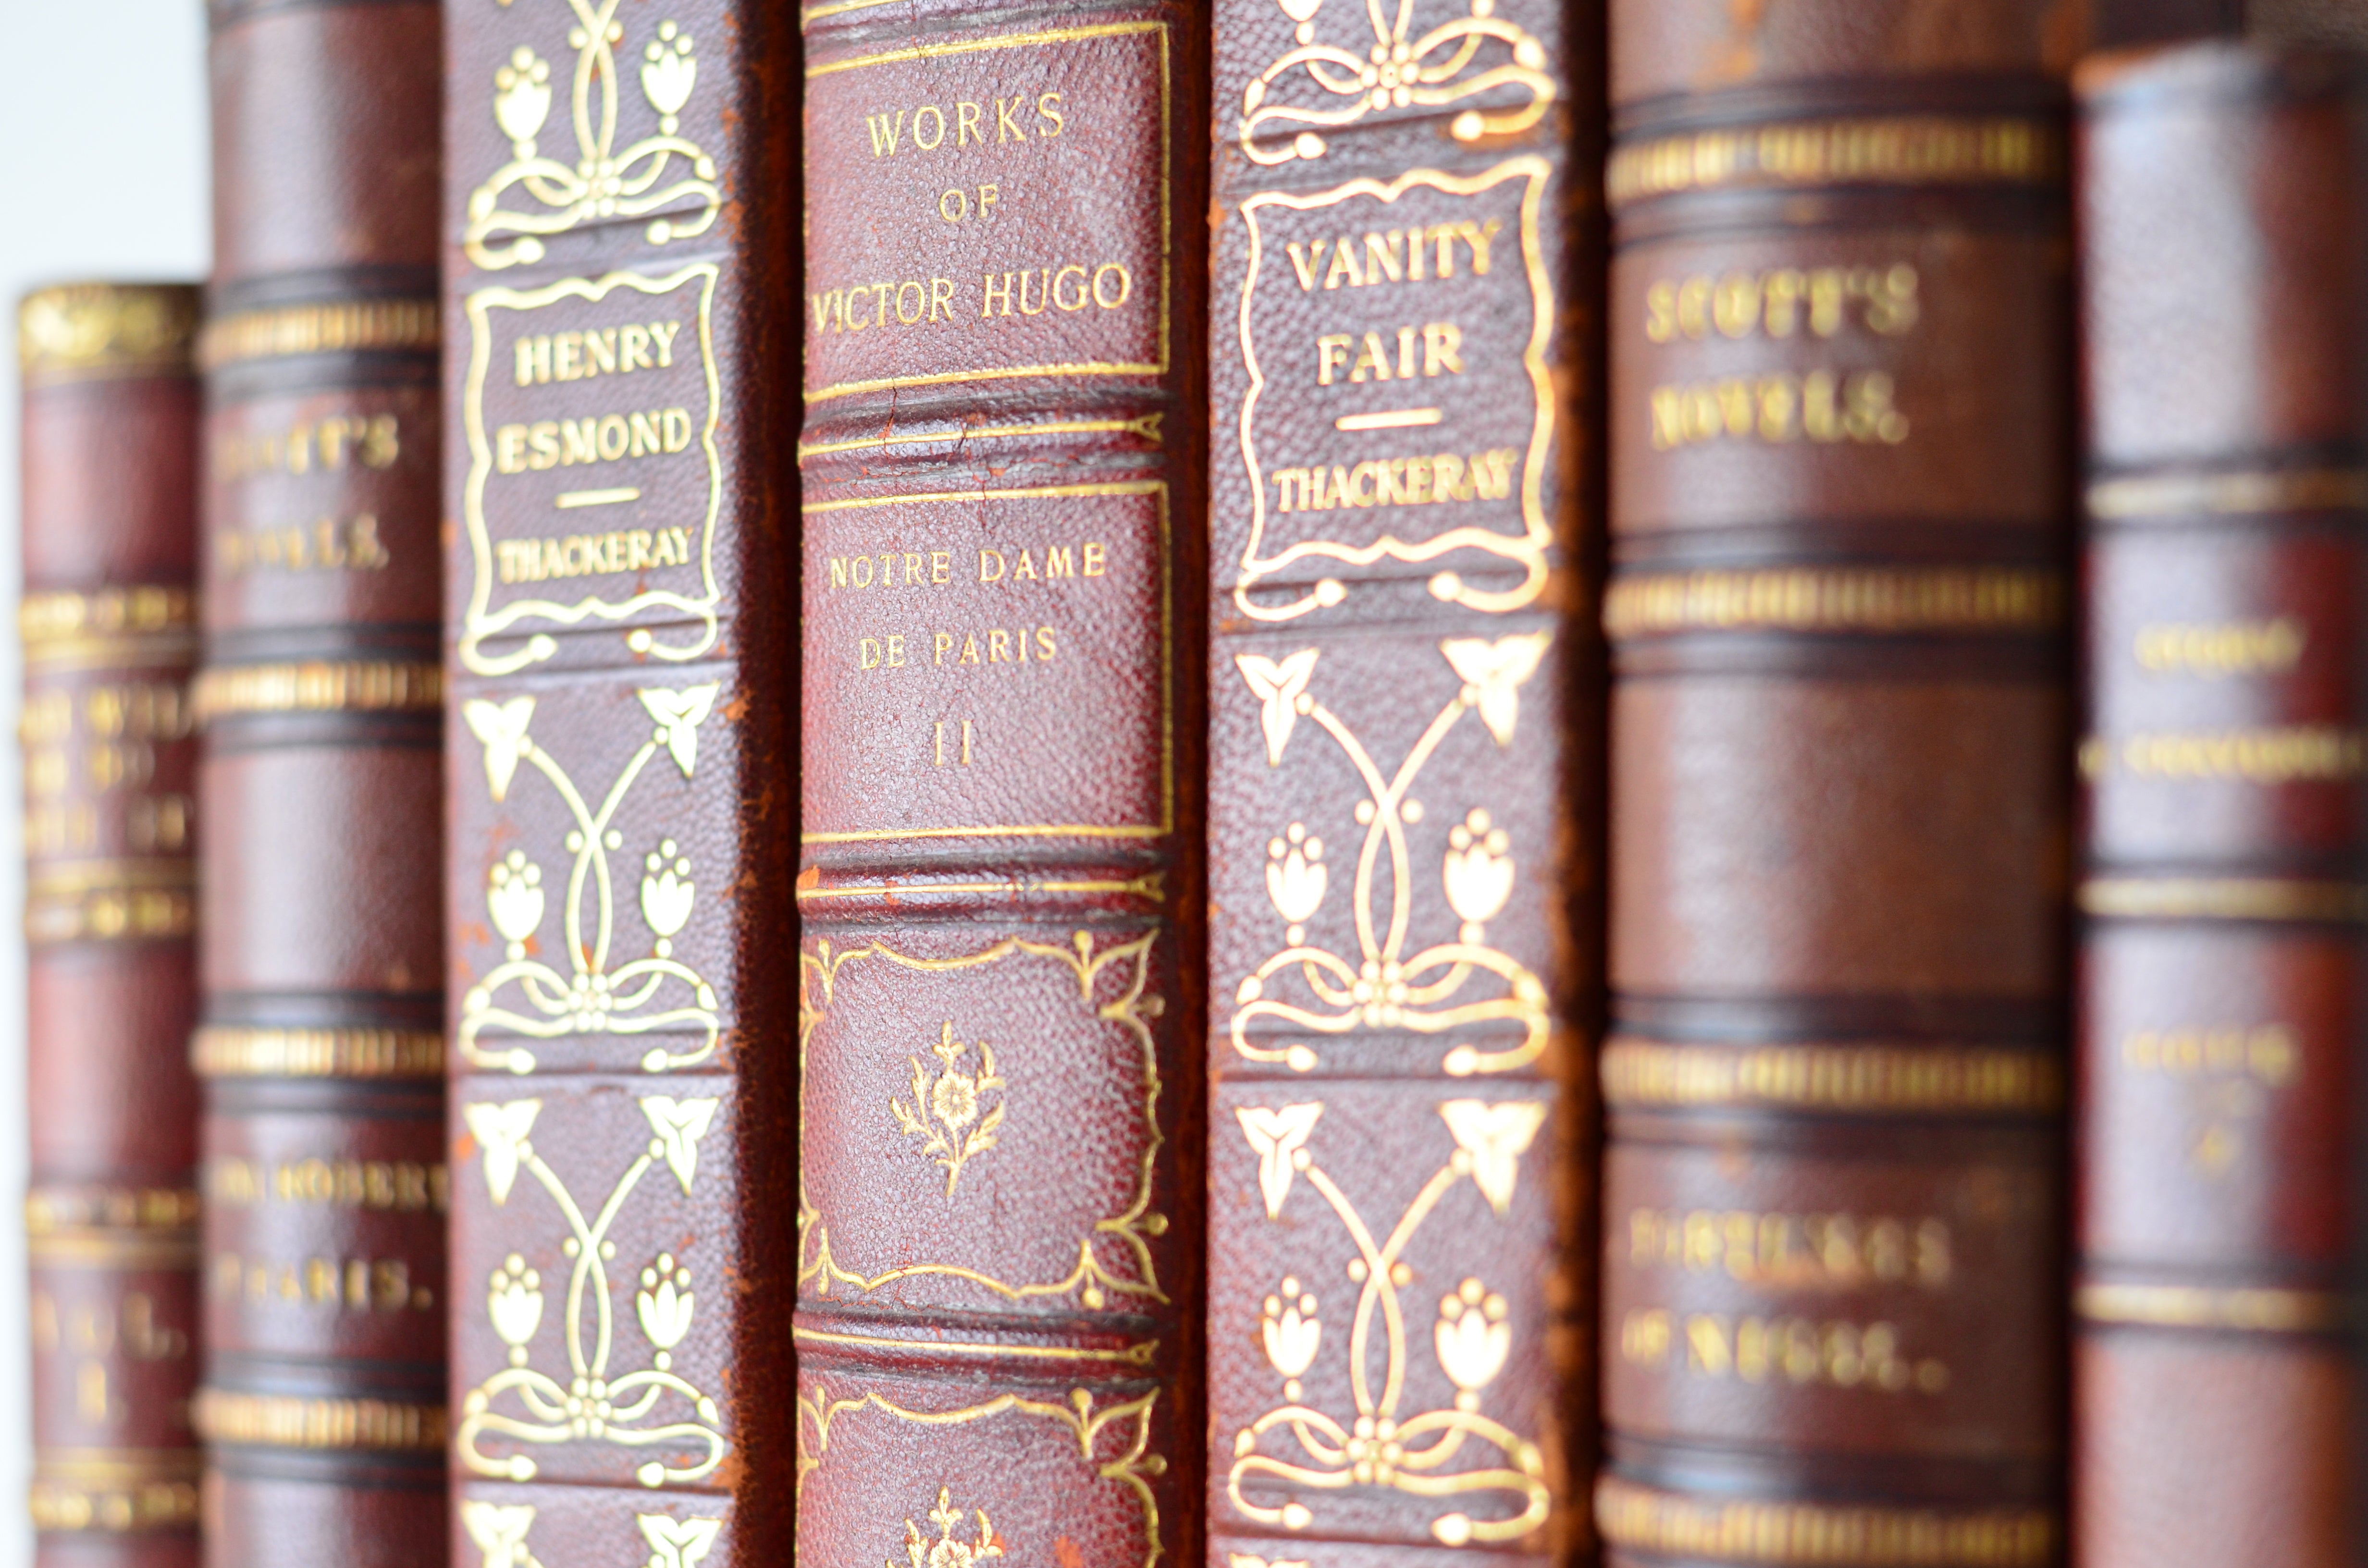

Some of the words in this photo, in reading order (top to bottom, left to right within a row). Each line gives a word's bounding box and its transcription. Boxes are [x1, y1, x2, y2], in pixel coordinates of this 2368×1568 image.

[866, 92, 1063, 158] WORKS
[939, 184, 998, 222] OF
[1286, 217, 1503, 291] VANITY
[813, 278, 954, 335] VICTOR
[982, 262, 1131, 318] HUGO
[515, 320, 680, 386] HENRY
[1317, 322, 1466, 386] FAIR
[496, 407, 691, 474] ESMOND
[1272, 447, 1517, 513] THACKERAY
[496, 526, 693, 584] THACKERAY
[830, 551, 951, 589] NOTRE
[979, 542, 1106, 582] DAME
[860, 635, 905, 670] DE
[934, 626, 1056, 665] PARIS
